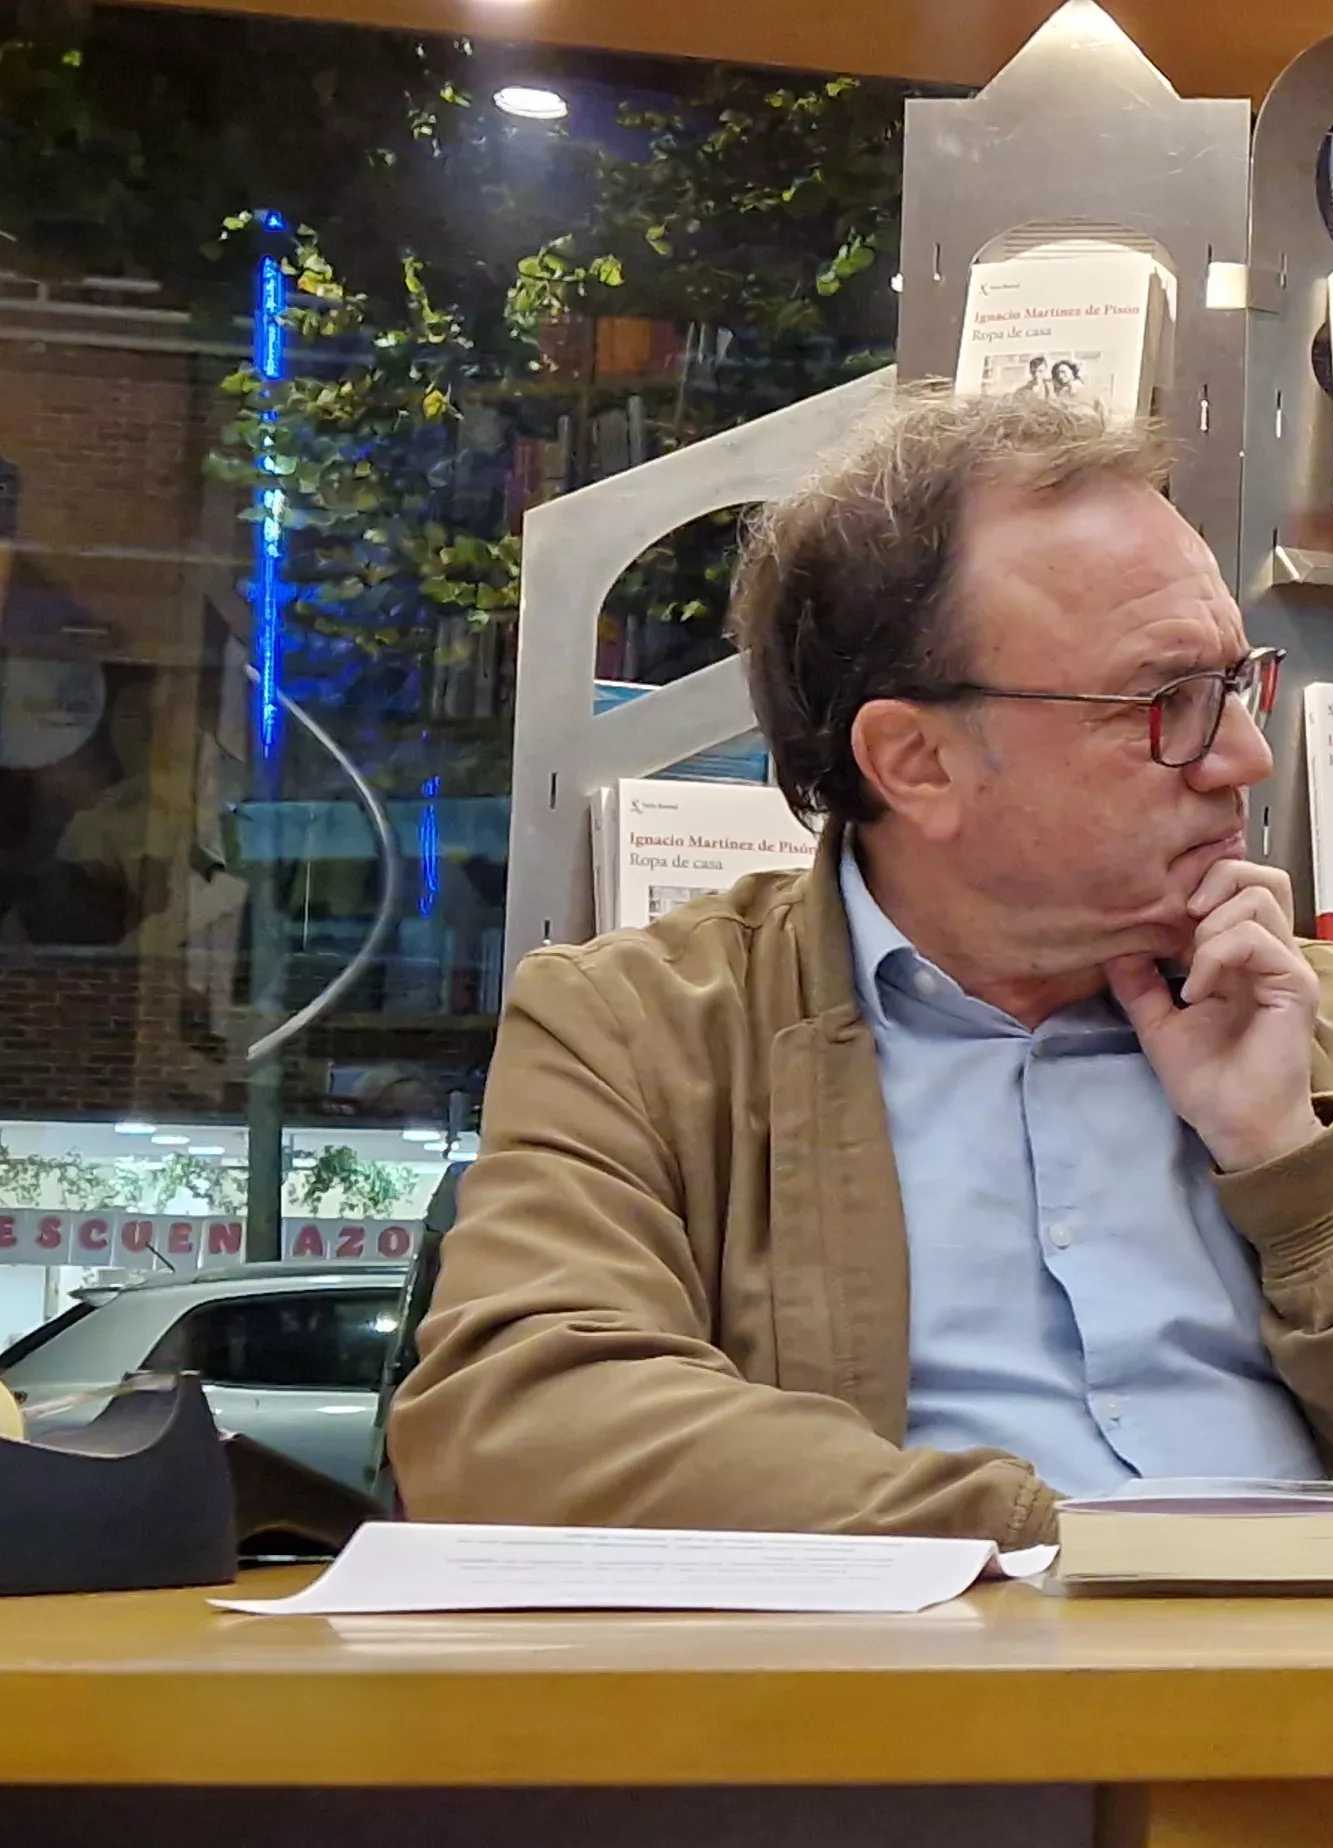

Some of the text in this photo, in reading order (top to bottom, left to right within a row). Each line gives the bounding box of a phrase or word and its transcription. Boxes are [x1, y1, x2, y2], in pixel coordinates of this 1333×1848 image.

[973, 308, 1021, 324] Ignacio
[1085, 304, 1100, 316] de
[972, 326, 1052, 343] Ropa de casa
[629, 832, 684, 848] Ignacio
[688, 835, 754, 851] Martínez
[758, 839, 774, 852] de
[629, 853, 723, 870] Ropa de casa
[0, 1216, 411, 1259] ESCUENAZO
